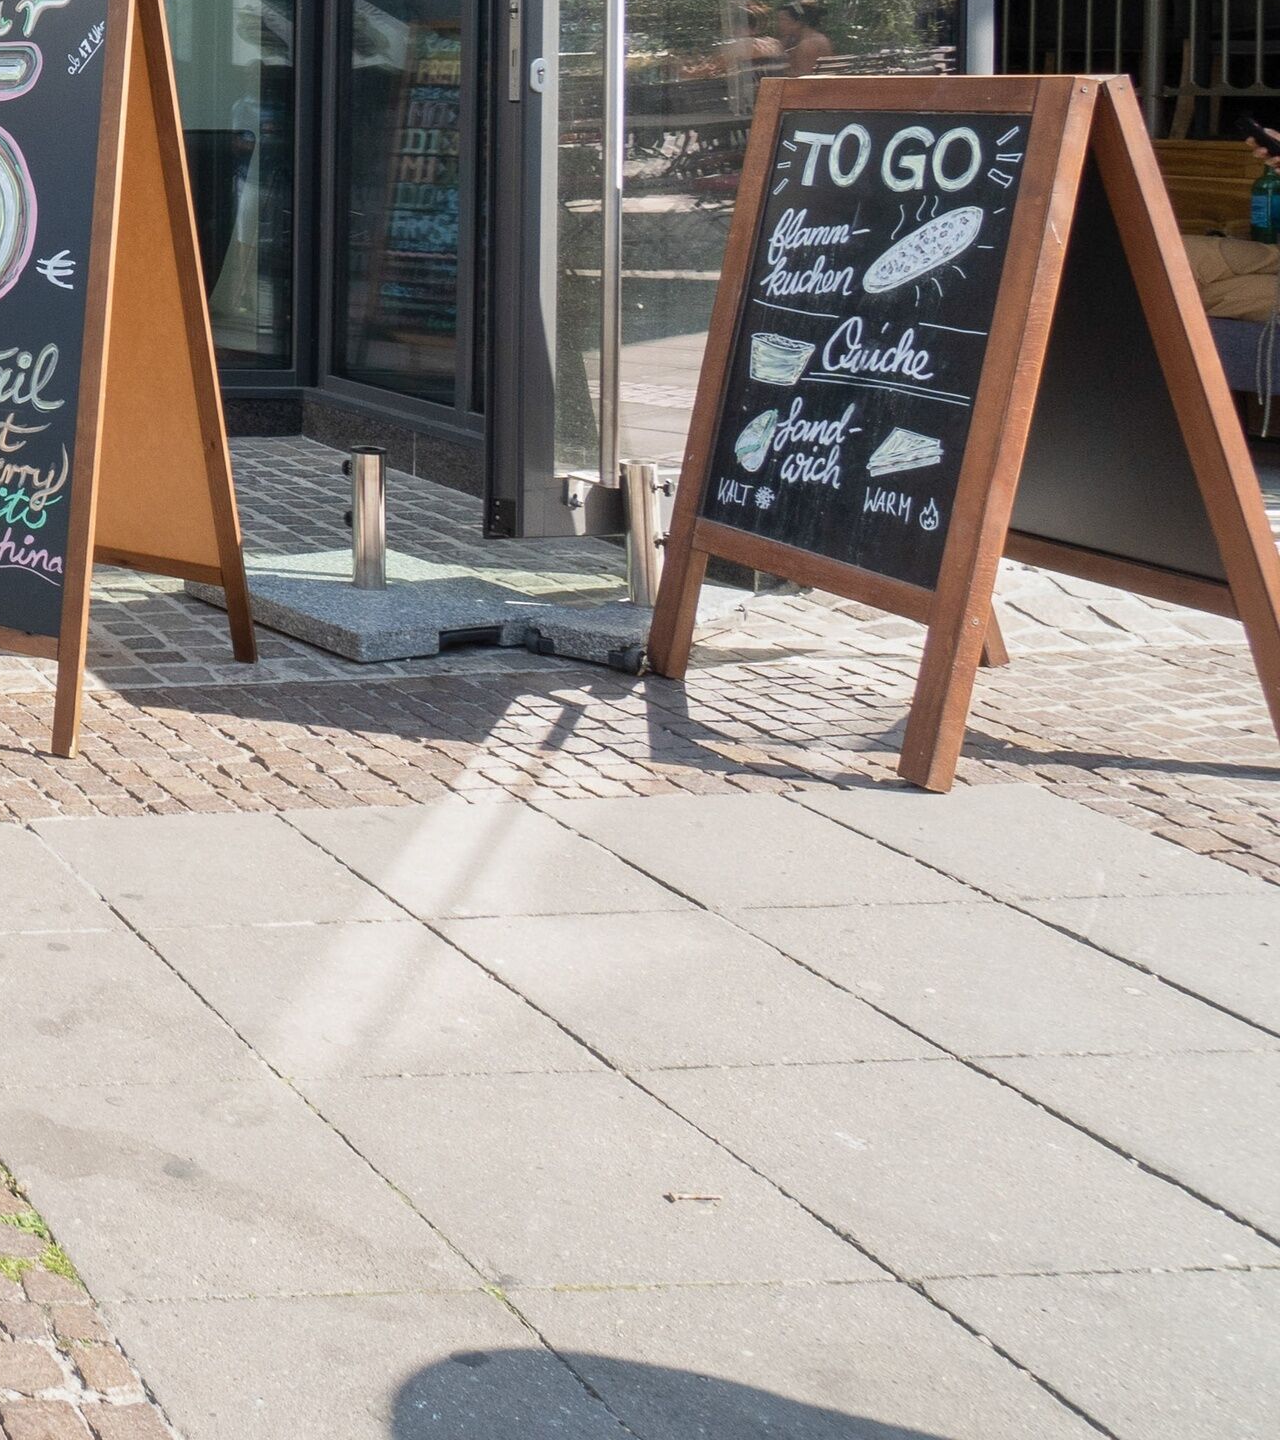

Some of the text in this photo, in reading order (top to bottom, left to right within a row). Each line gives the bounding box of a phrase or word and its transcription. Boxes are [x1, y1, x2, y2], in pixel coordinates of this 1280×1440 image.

[67, 20, 105, 75] ab 17 Uhr
[793, 123, 983, 192] TO GO
[761, 259, 852, 297] kuchen
[821, 316, 934, 381] Quiche
[779, 444, 841, 491] wich
[717, 476, 911, 523] KALT WARM
